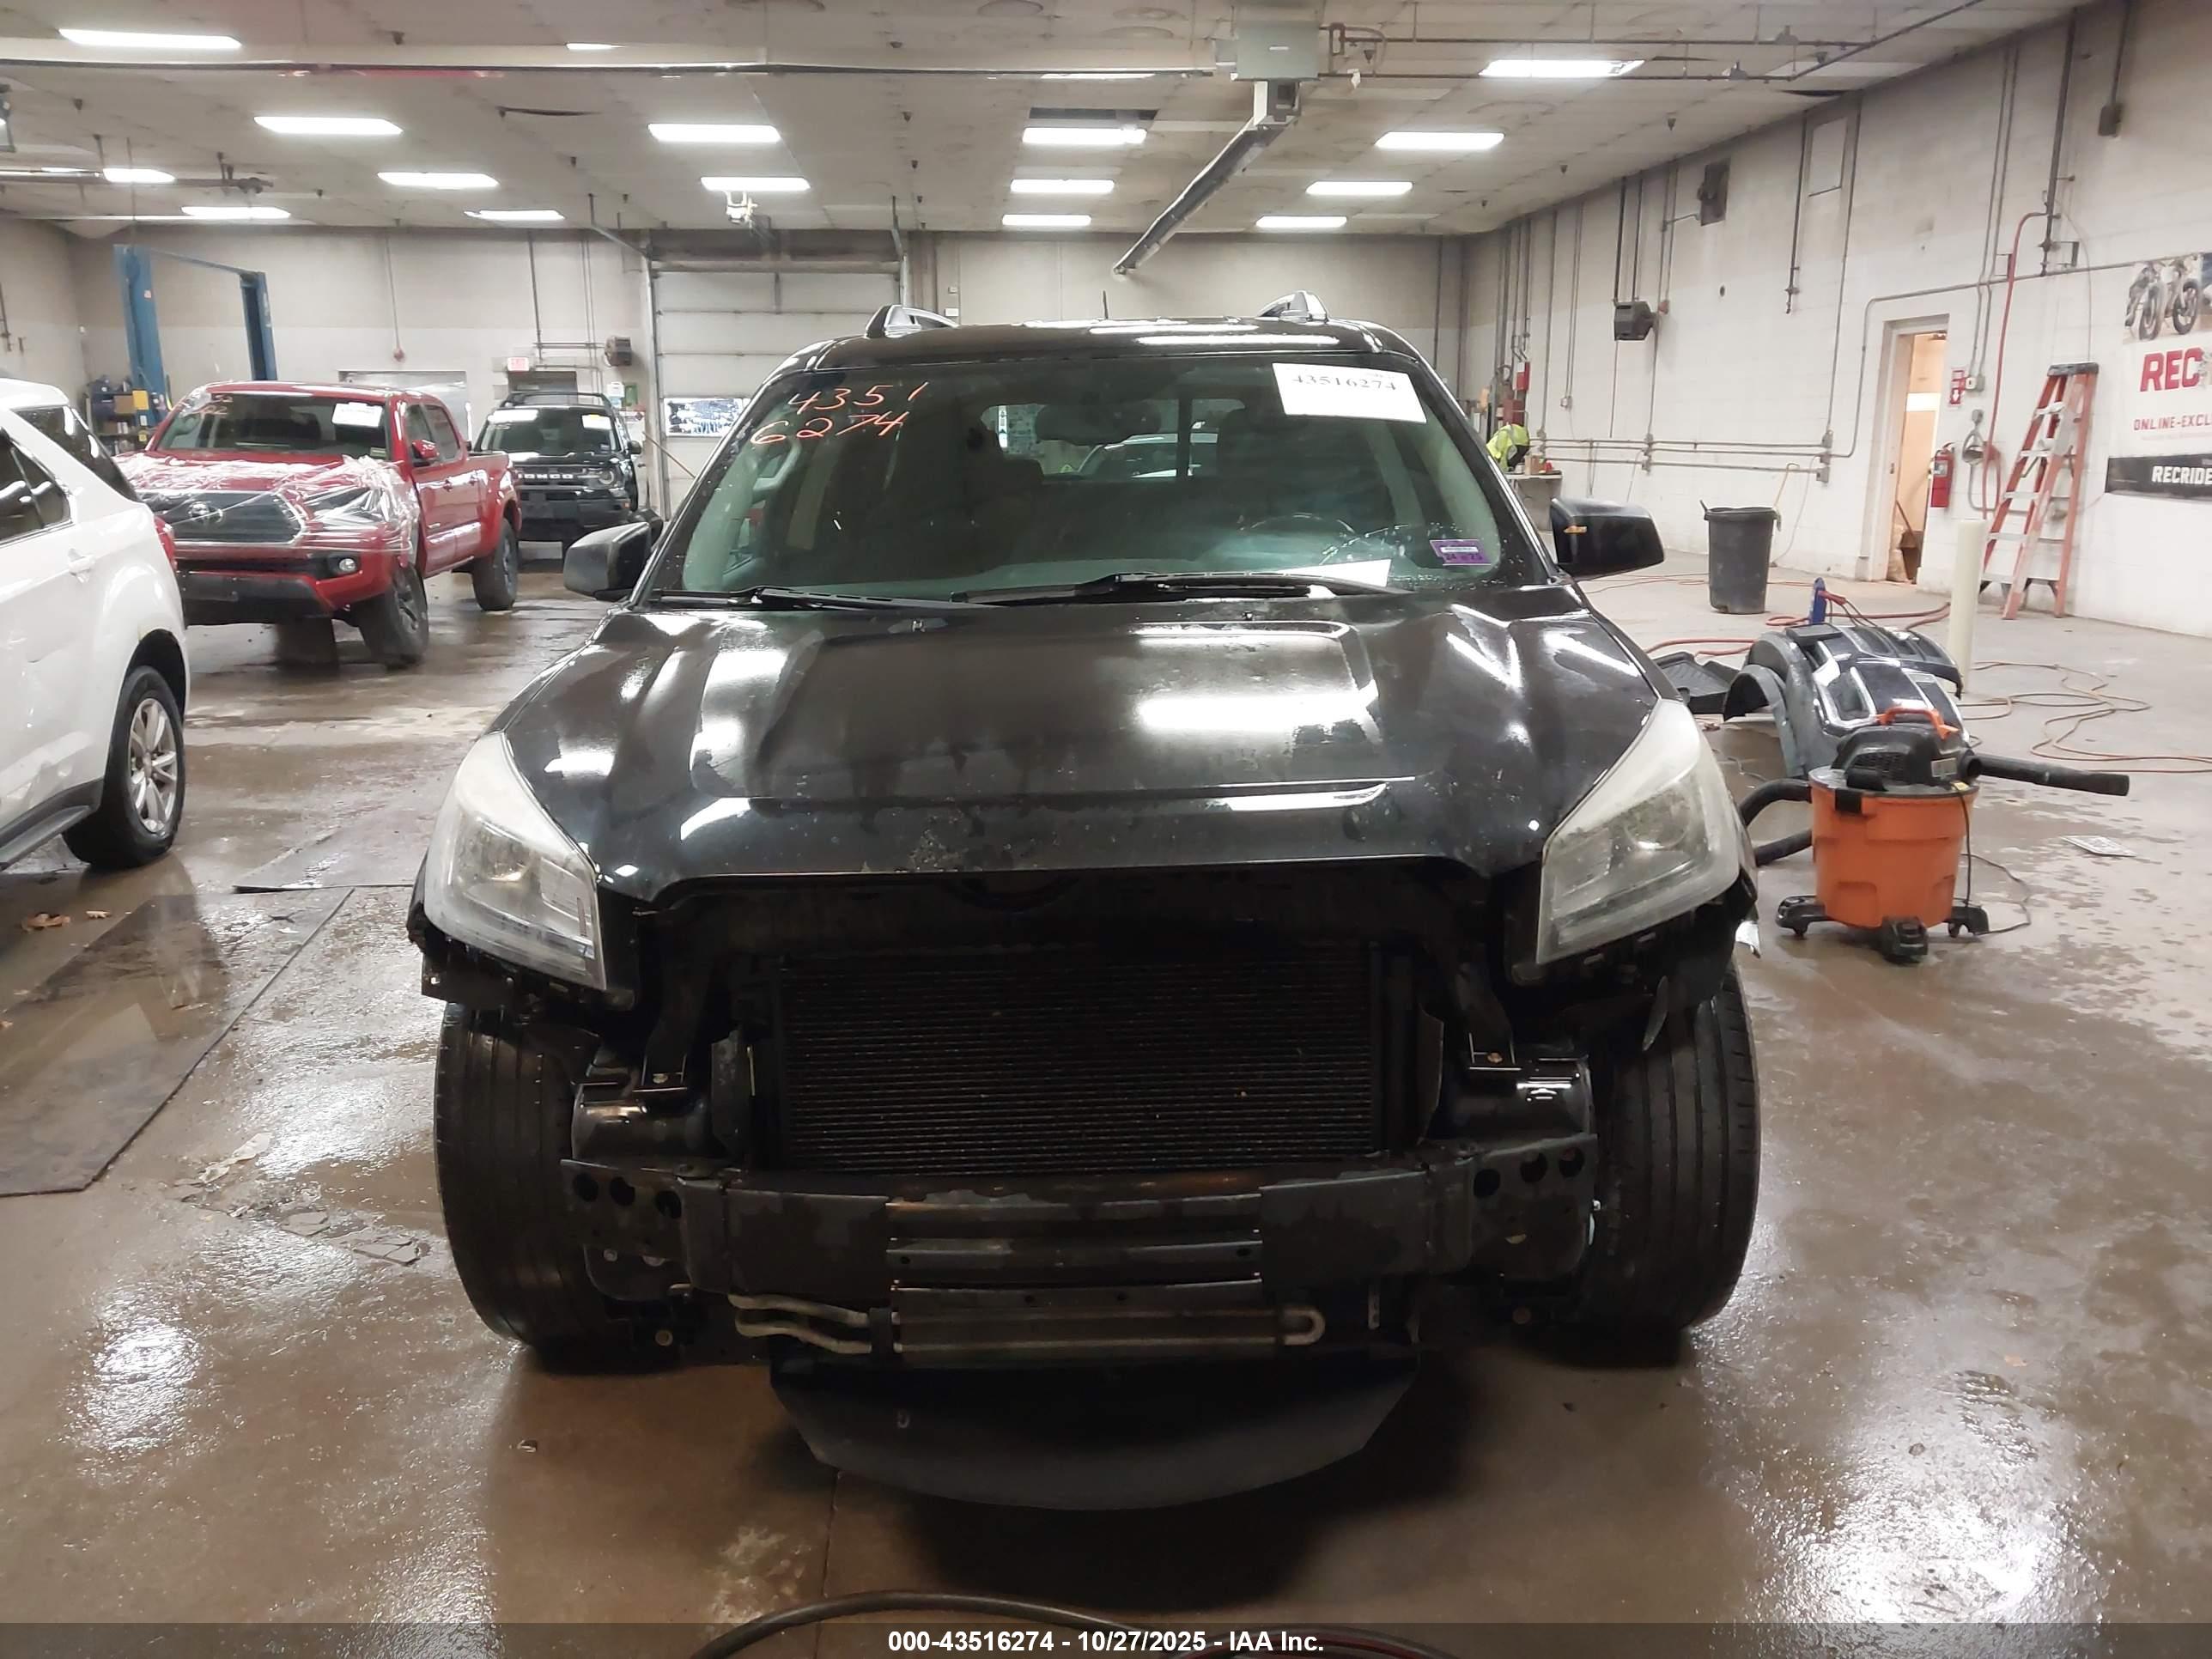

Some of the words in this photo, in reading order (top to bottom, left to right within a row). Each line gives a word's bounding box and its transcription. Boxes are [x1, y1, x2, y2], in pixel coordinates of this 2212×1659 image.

[1292, 375, 1396, 391] 43516274
[2140, 347, 2204, 392] REC
[787, 382, 929, 415] 4351
[750, 410, 909, 444] 6274
